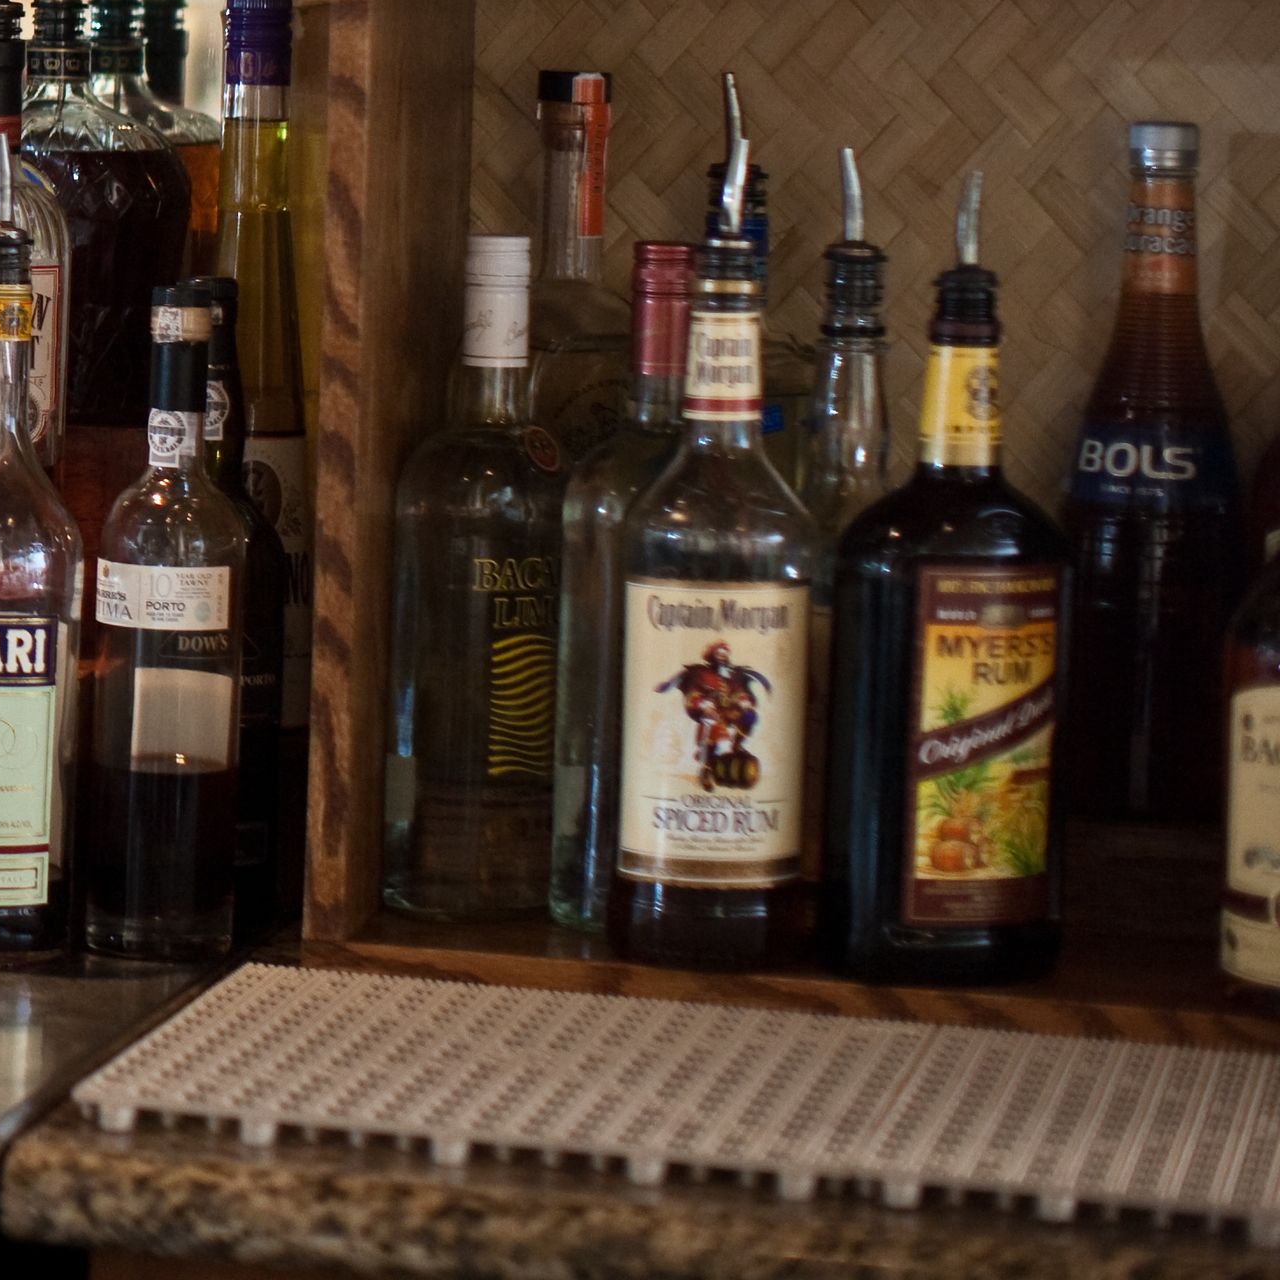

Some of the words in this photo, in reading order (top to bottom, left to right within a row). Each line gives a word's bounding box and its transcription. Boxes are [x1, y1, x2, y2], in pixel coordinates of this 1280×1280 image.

[1078, 438, 1198, 480] BOLS
[149, 572, 172, 599] 10
[145, 600, 187, 612] PORTO
[646, 594, 717, 634] Captain
[719, 597, 789, 636] Morgan
[177, 632, 230, 652] DOW'S
[971, 660, 1032, 686] RUM
[680, 794, 752, 809] ORIGINAL
[652, 806, 728, 834] SPICED
[732, 806, 781, 834] RUM
